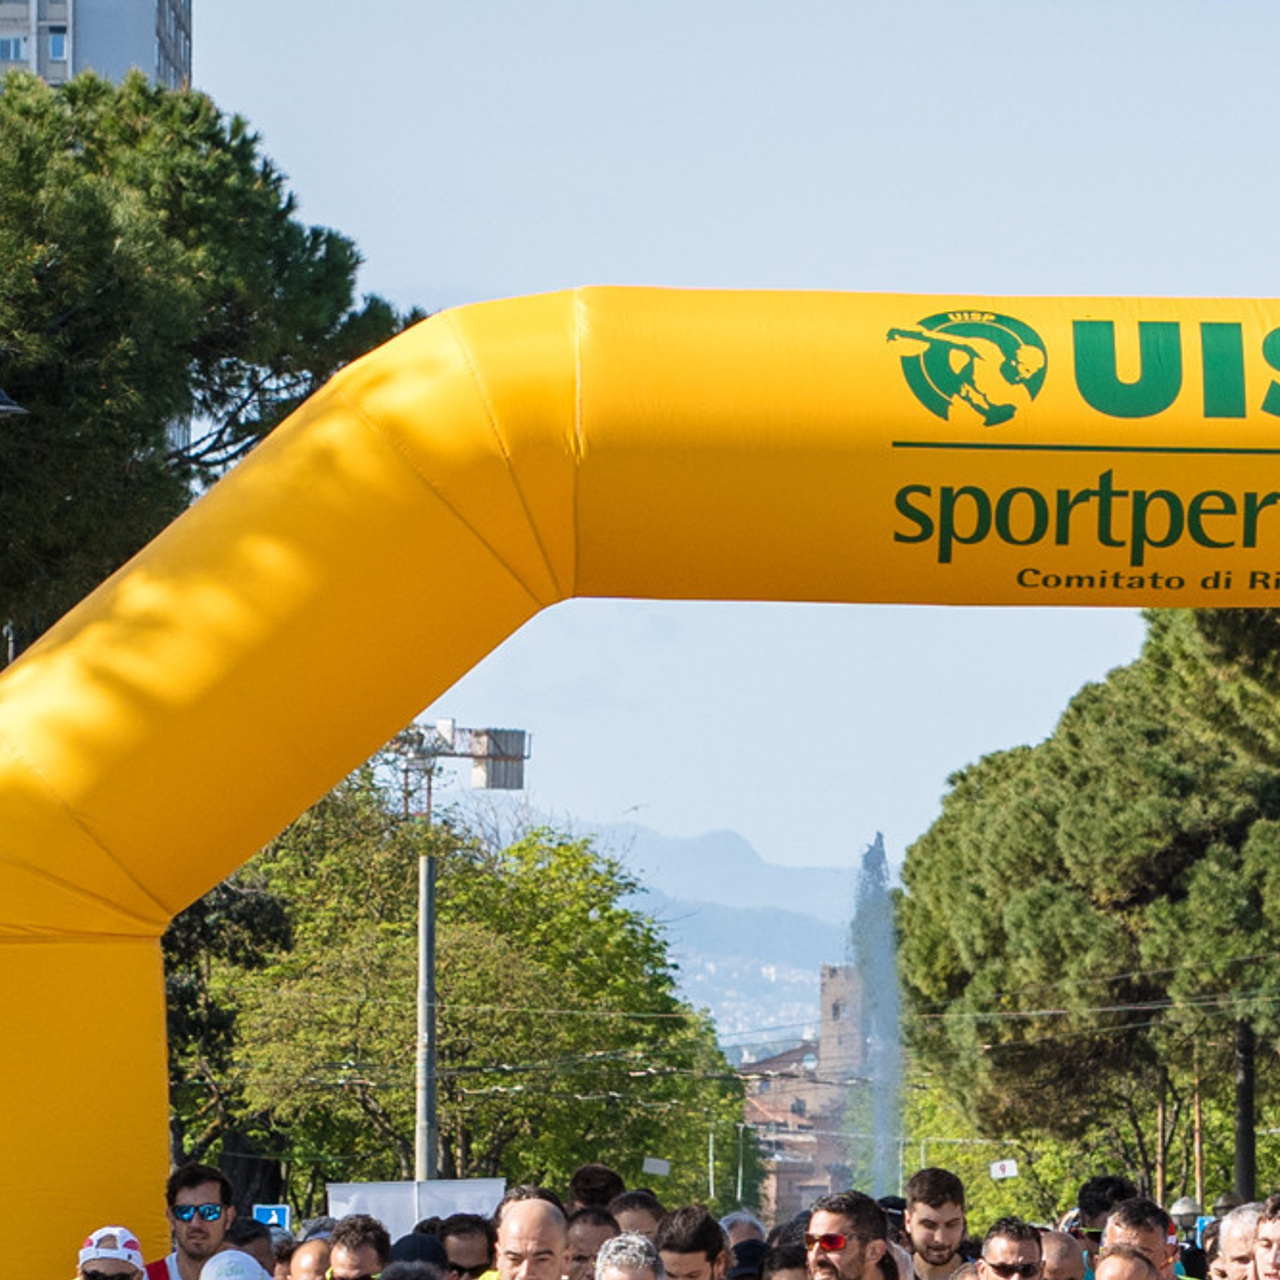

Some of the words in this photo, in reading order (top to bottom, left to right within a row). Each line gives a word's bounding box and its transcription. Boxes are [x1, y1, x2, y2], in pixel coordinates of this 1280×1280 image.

[948, 312, 995, 321] UISP
[1016, 568, 1186, 591] Comitato
[1201, 570, 1234, 591] di
